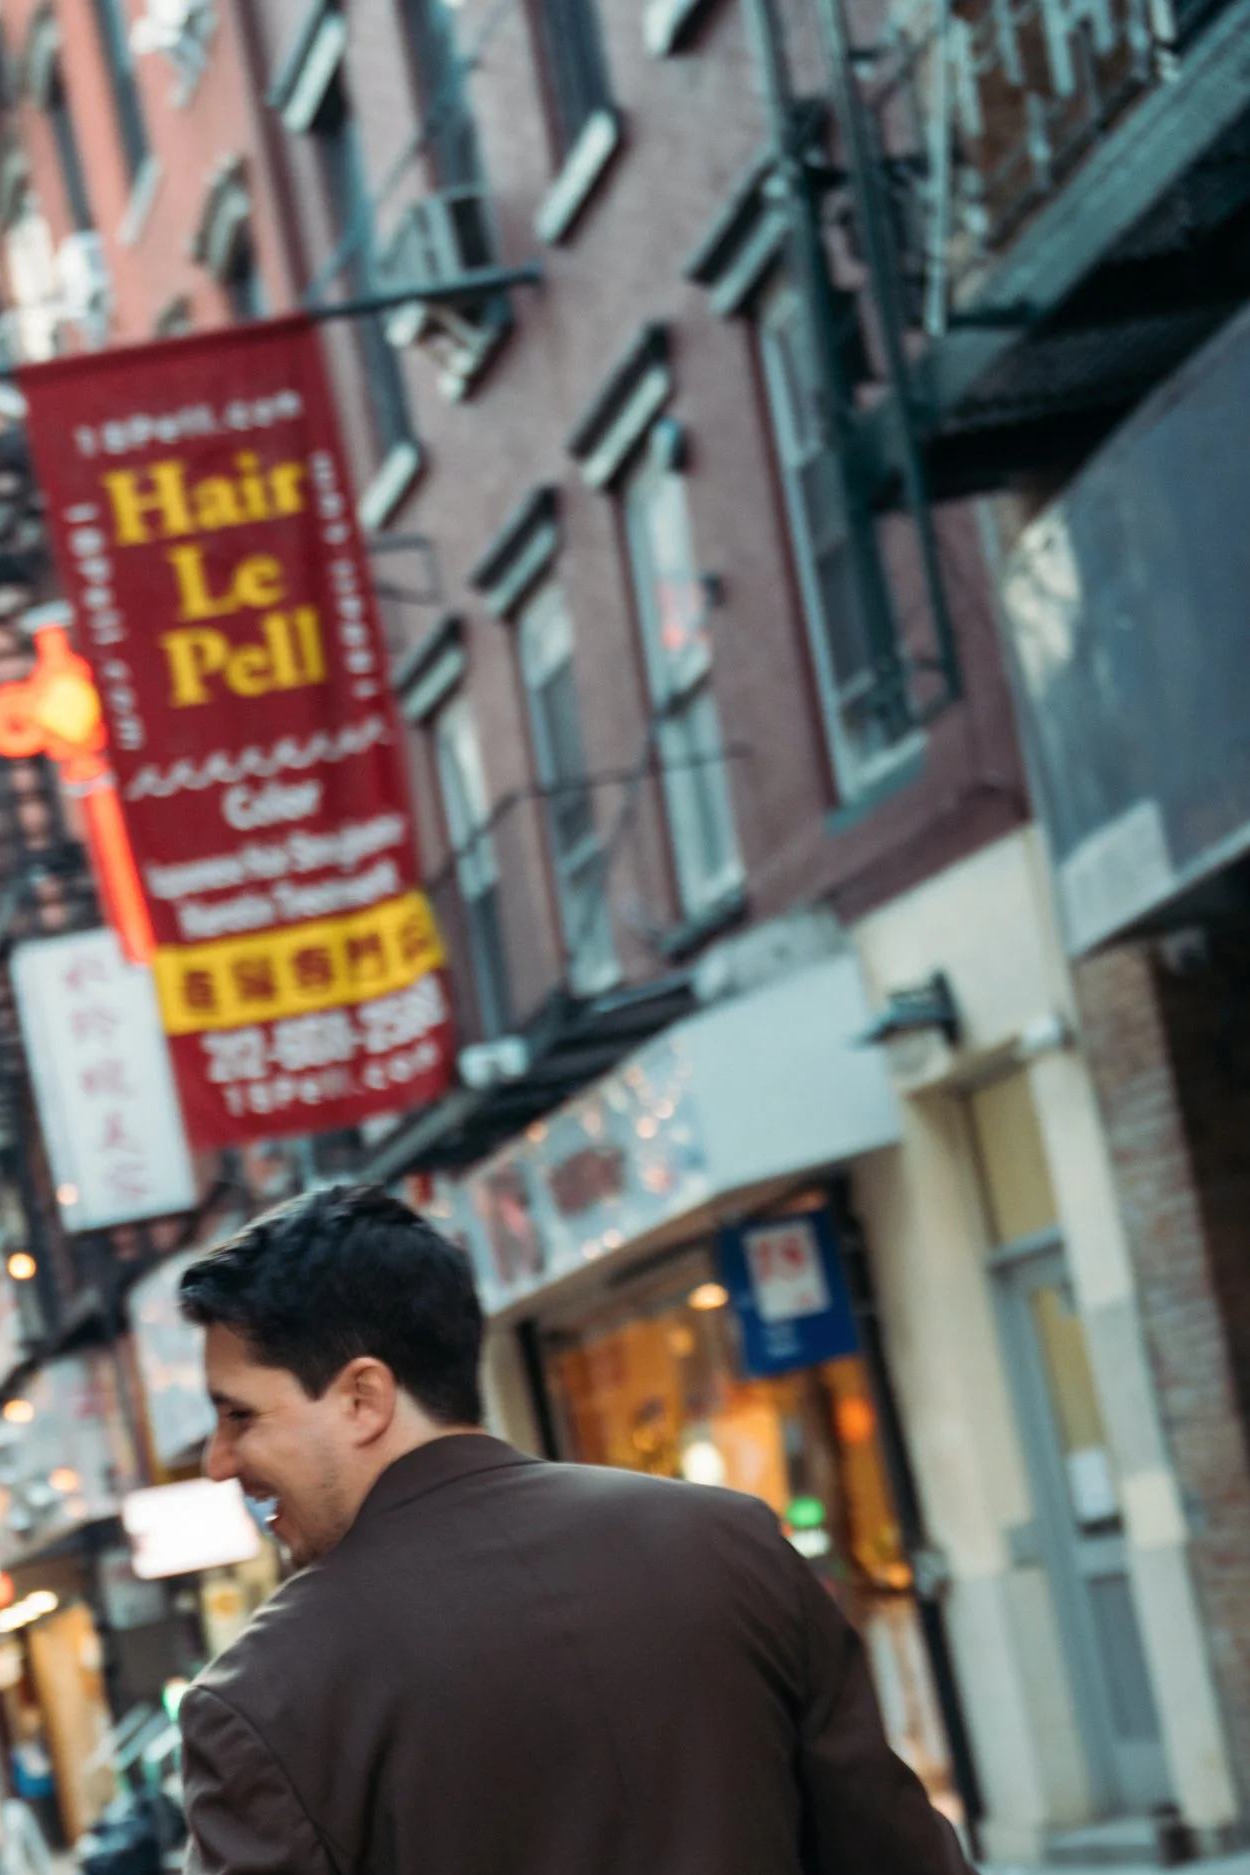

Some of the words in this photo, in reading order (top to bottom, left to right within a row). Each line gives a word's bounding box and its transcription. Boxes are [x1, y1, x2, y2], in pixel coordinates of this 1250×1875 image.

[104, 451, 306, 547] Hair
[169, 546, 283, 620] Le
[162, 606, 326, 706] Pell
